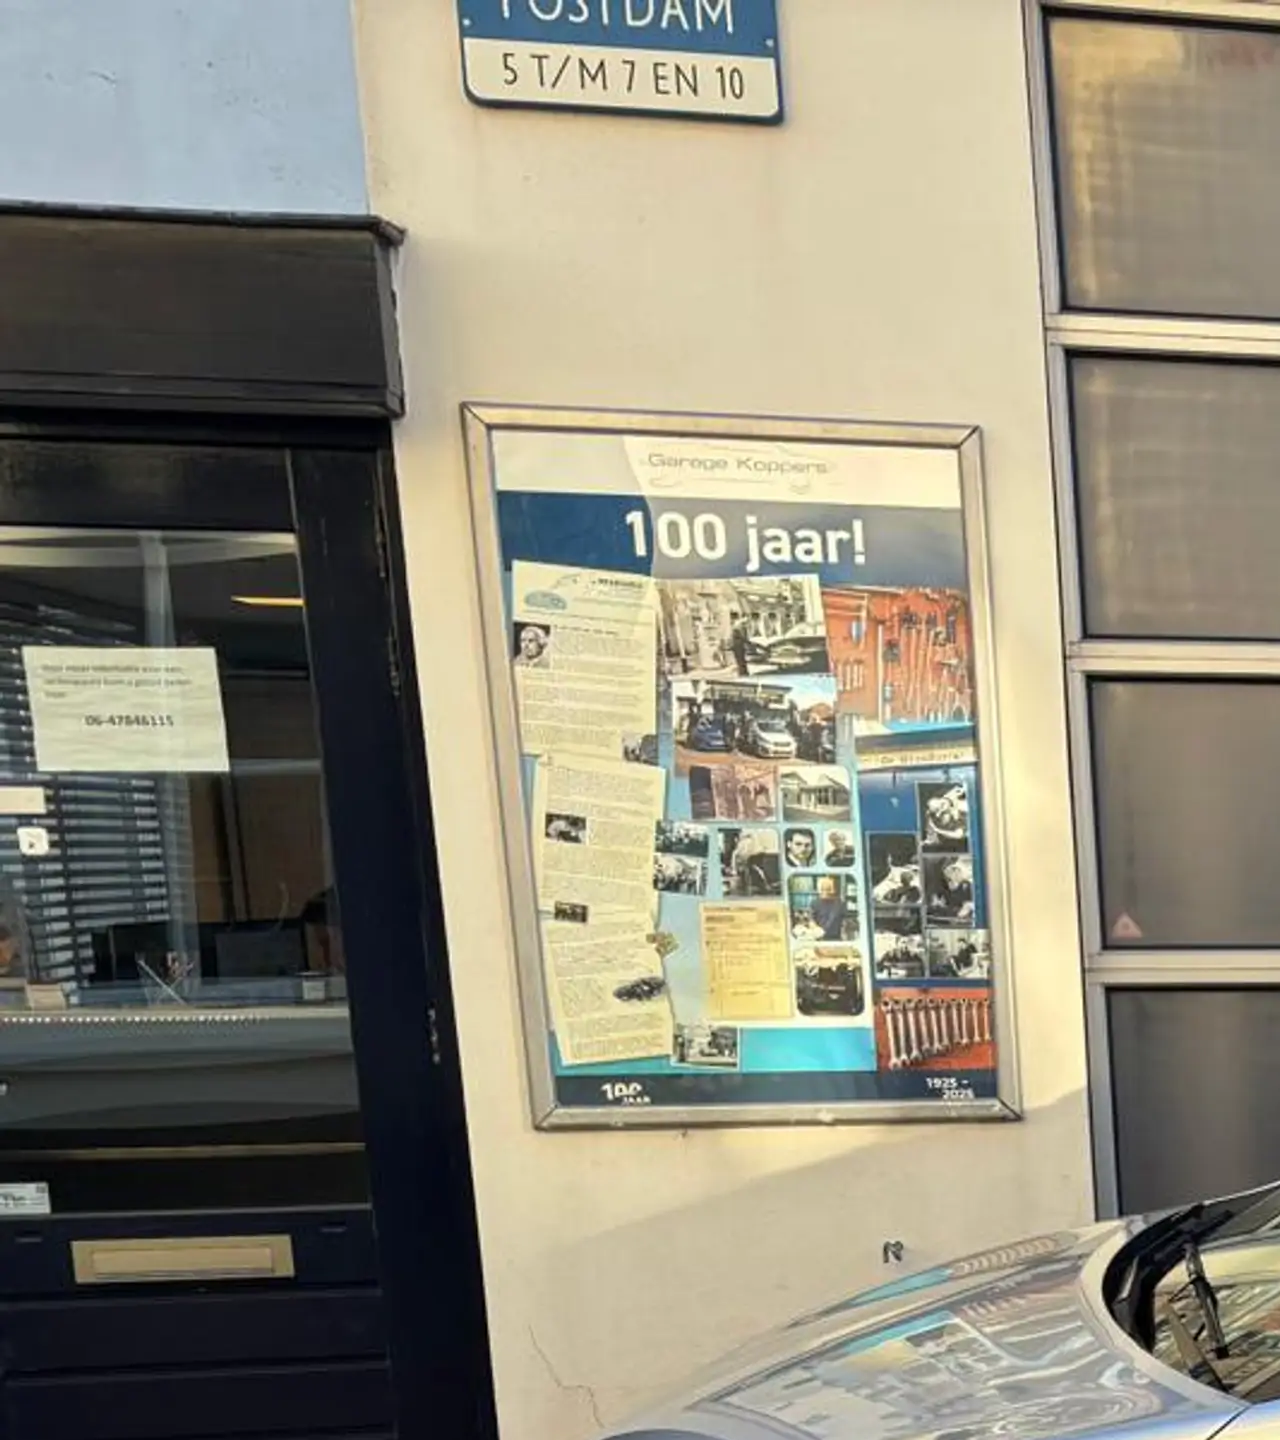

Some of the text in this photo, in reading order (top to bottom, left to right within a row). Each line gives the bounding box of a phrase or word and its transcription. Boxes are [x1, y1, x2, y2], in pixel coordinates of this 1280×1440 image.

[501, 53, 745, 100] 5 T/M 7 EN 10
[648, 453, 828, 475] Garage Koppers
[625, 510, 866, 573] 100 jaar!
